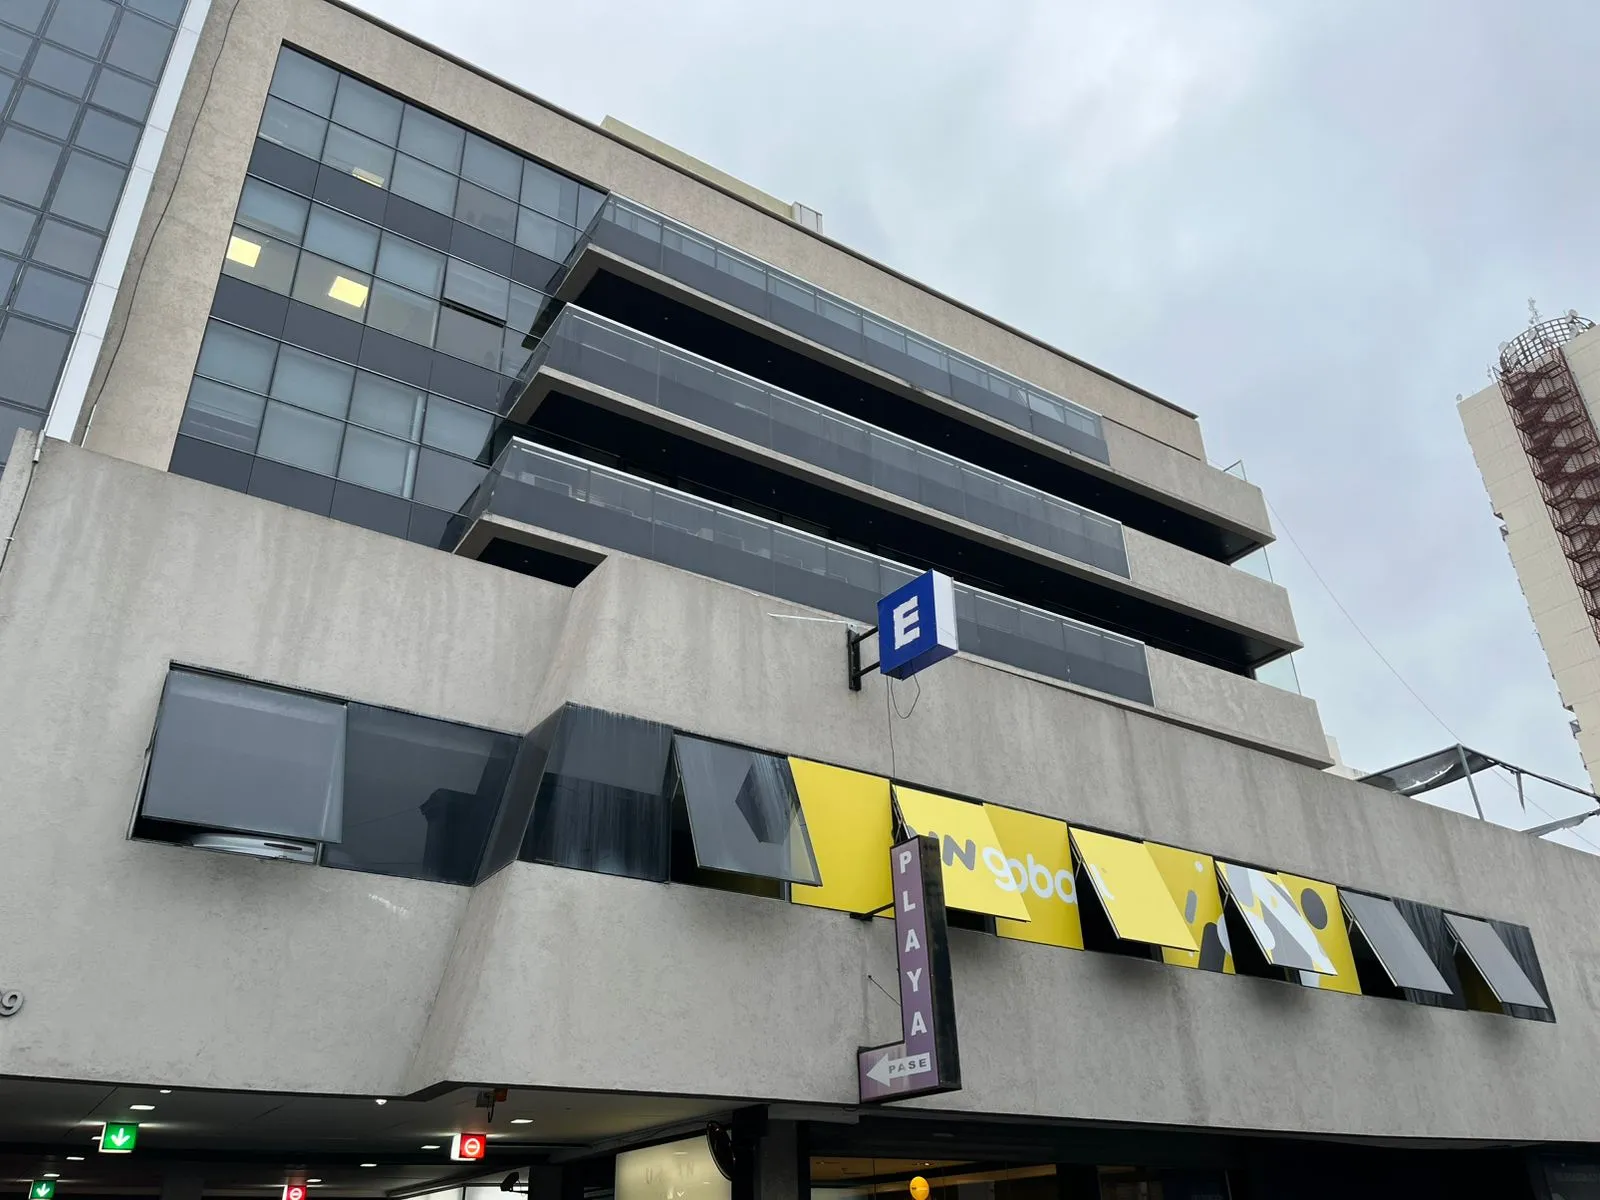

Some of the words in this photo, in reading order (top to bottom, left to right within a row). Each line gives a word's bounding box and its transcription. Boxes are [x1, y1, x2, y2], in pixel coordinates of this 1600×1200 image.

[893, 595, 920, 651] E
[899, 850, 928, 1036] PLAYA
[888, 1058, 927, 1074] PASE
